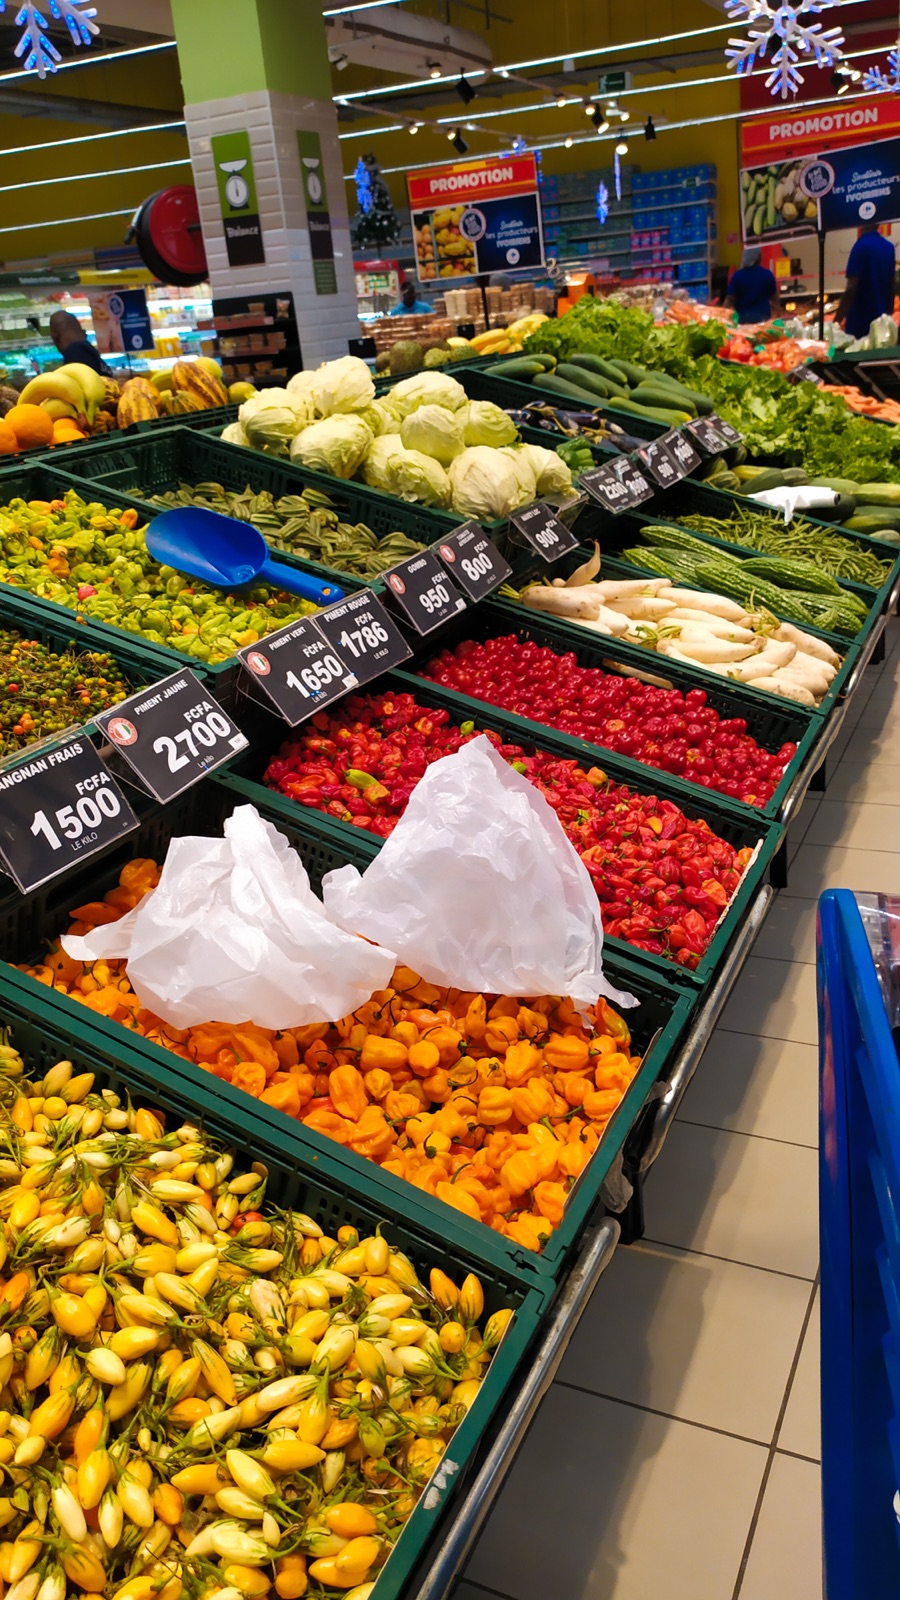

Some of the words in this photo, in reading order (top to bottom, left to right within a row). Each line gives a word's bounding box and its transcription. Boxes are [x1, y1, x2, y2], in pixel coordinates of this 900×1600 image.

[769, 107, 878, 140] PROMOTION
[430, 167, 513, 193] PROMOTION
[832, 186, 845, 194] les
[847, 174, 900, 194] producteurs
[226, 225, 258, 239] Balance
[497, 226, 538, 240] producteurs
[545, 518, 558, 530] FCFA
[473, 540, 489, 553] FCFA
[535, 527, 559, 548] 900
[407, 558, 427, 574] GOMBO
[431, 570, 448, 585] FCFA
[461, 553, 493, 581] 800
[323, 606, 350, 623] PIMENT
[348, 595, 371, 611] ROUGE
[419, 584, 450, 614] 950
[354, 611, 375, 628] FCFA
[268, 634, 291, 651] PIMENT
[290, 626, 307, 640] VERT
[302, 640, 326, 658] FCFA
[340, 621, 389, 658] 1786
[373, 652, 380, 660] LE
[379, 648, 389, 657] KILO
[286, 654, 344, 699] 1650
[133, 694, 164, 716] PIMENT
[164, 678, 189, 699] JAUNE
[183, 700, 214, 723] FCFA
[153, 711, 231, 774] 2700
[47, 743, 84, 767] FRAIS
[197, 759, 206, 769] Le
[204, 754, 215, 764] kilo
[75, 771, 111, 795] FCFA
[30, 787, 121, 851] 1500
[71, 840, 82, 851] LE
[81, 831, 98, 846] KILO
